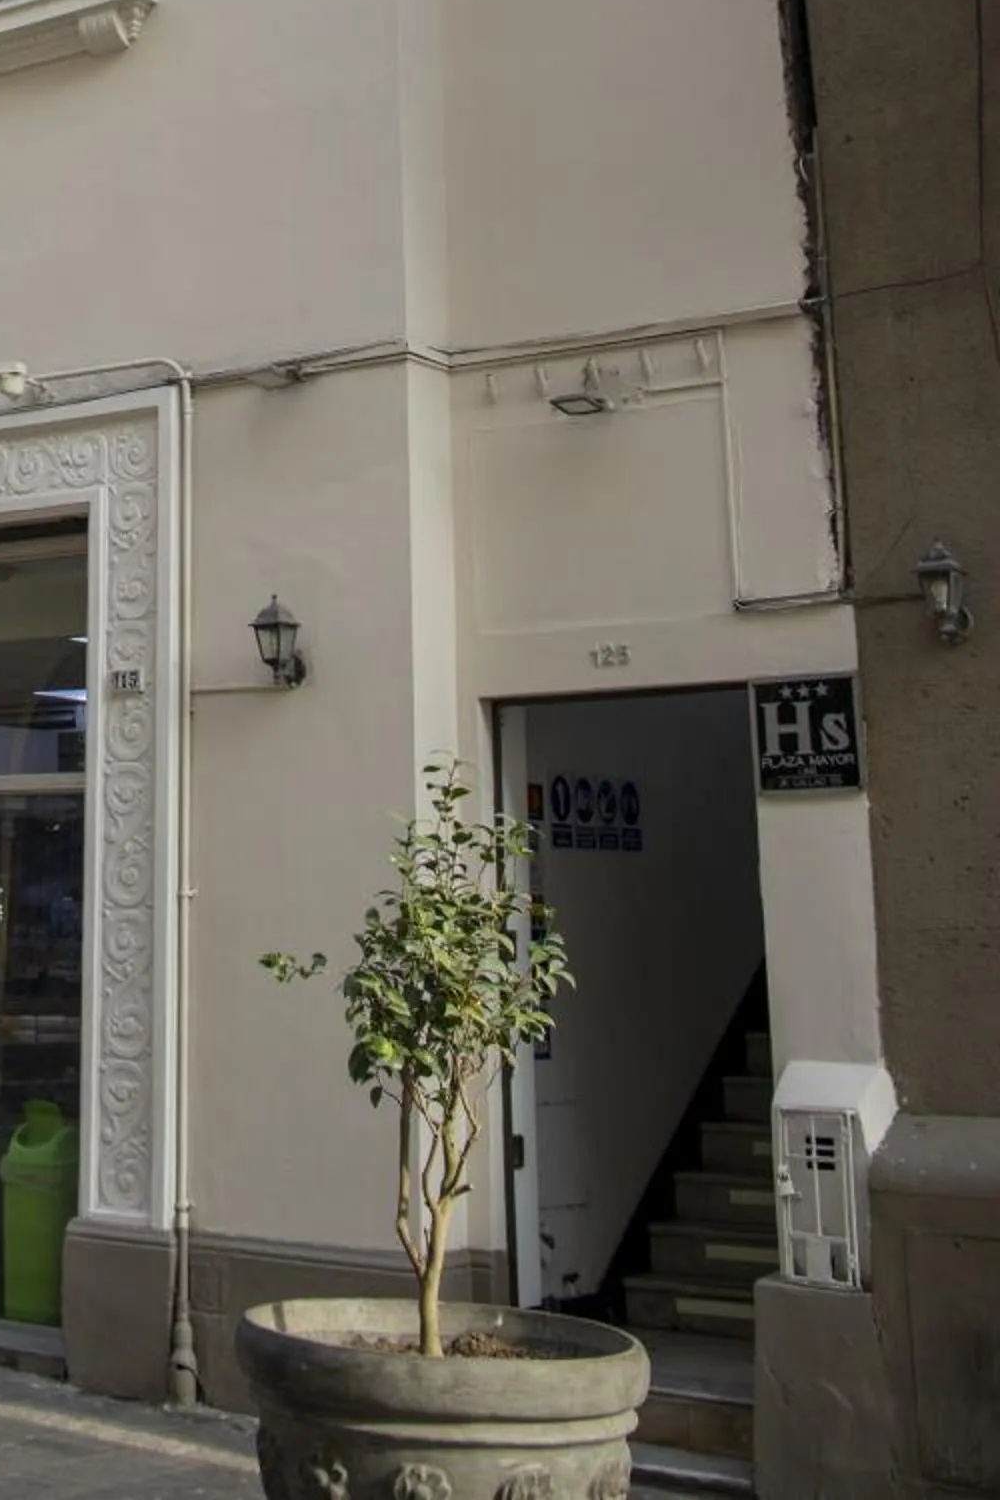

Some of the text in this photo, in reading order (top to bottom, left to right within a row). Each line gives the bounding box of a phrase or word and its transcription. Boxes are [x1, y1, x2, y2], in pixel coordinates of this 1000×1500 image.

[588, 643, 632, 670] 125
[761, 752, 856, 770] PLAZA MAYOR
